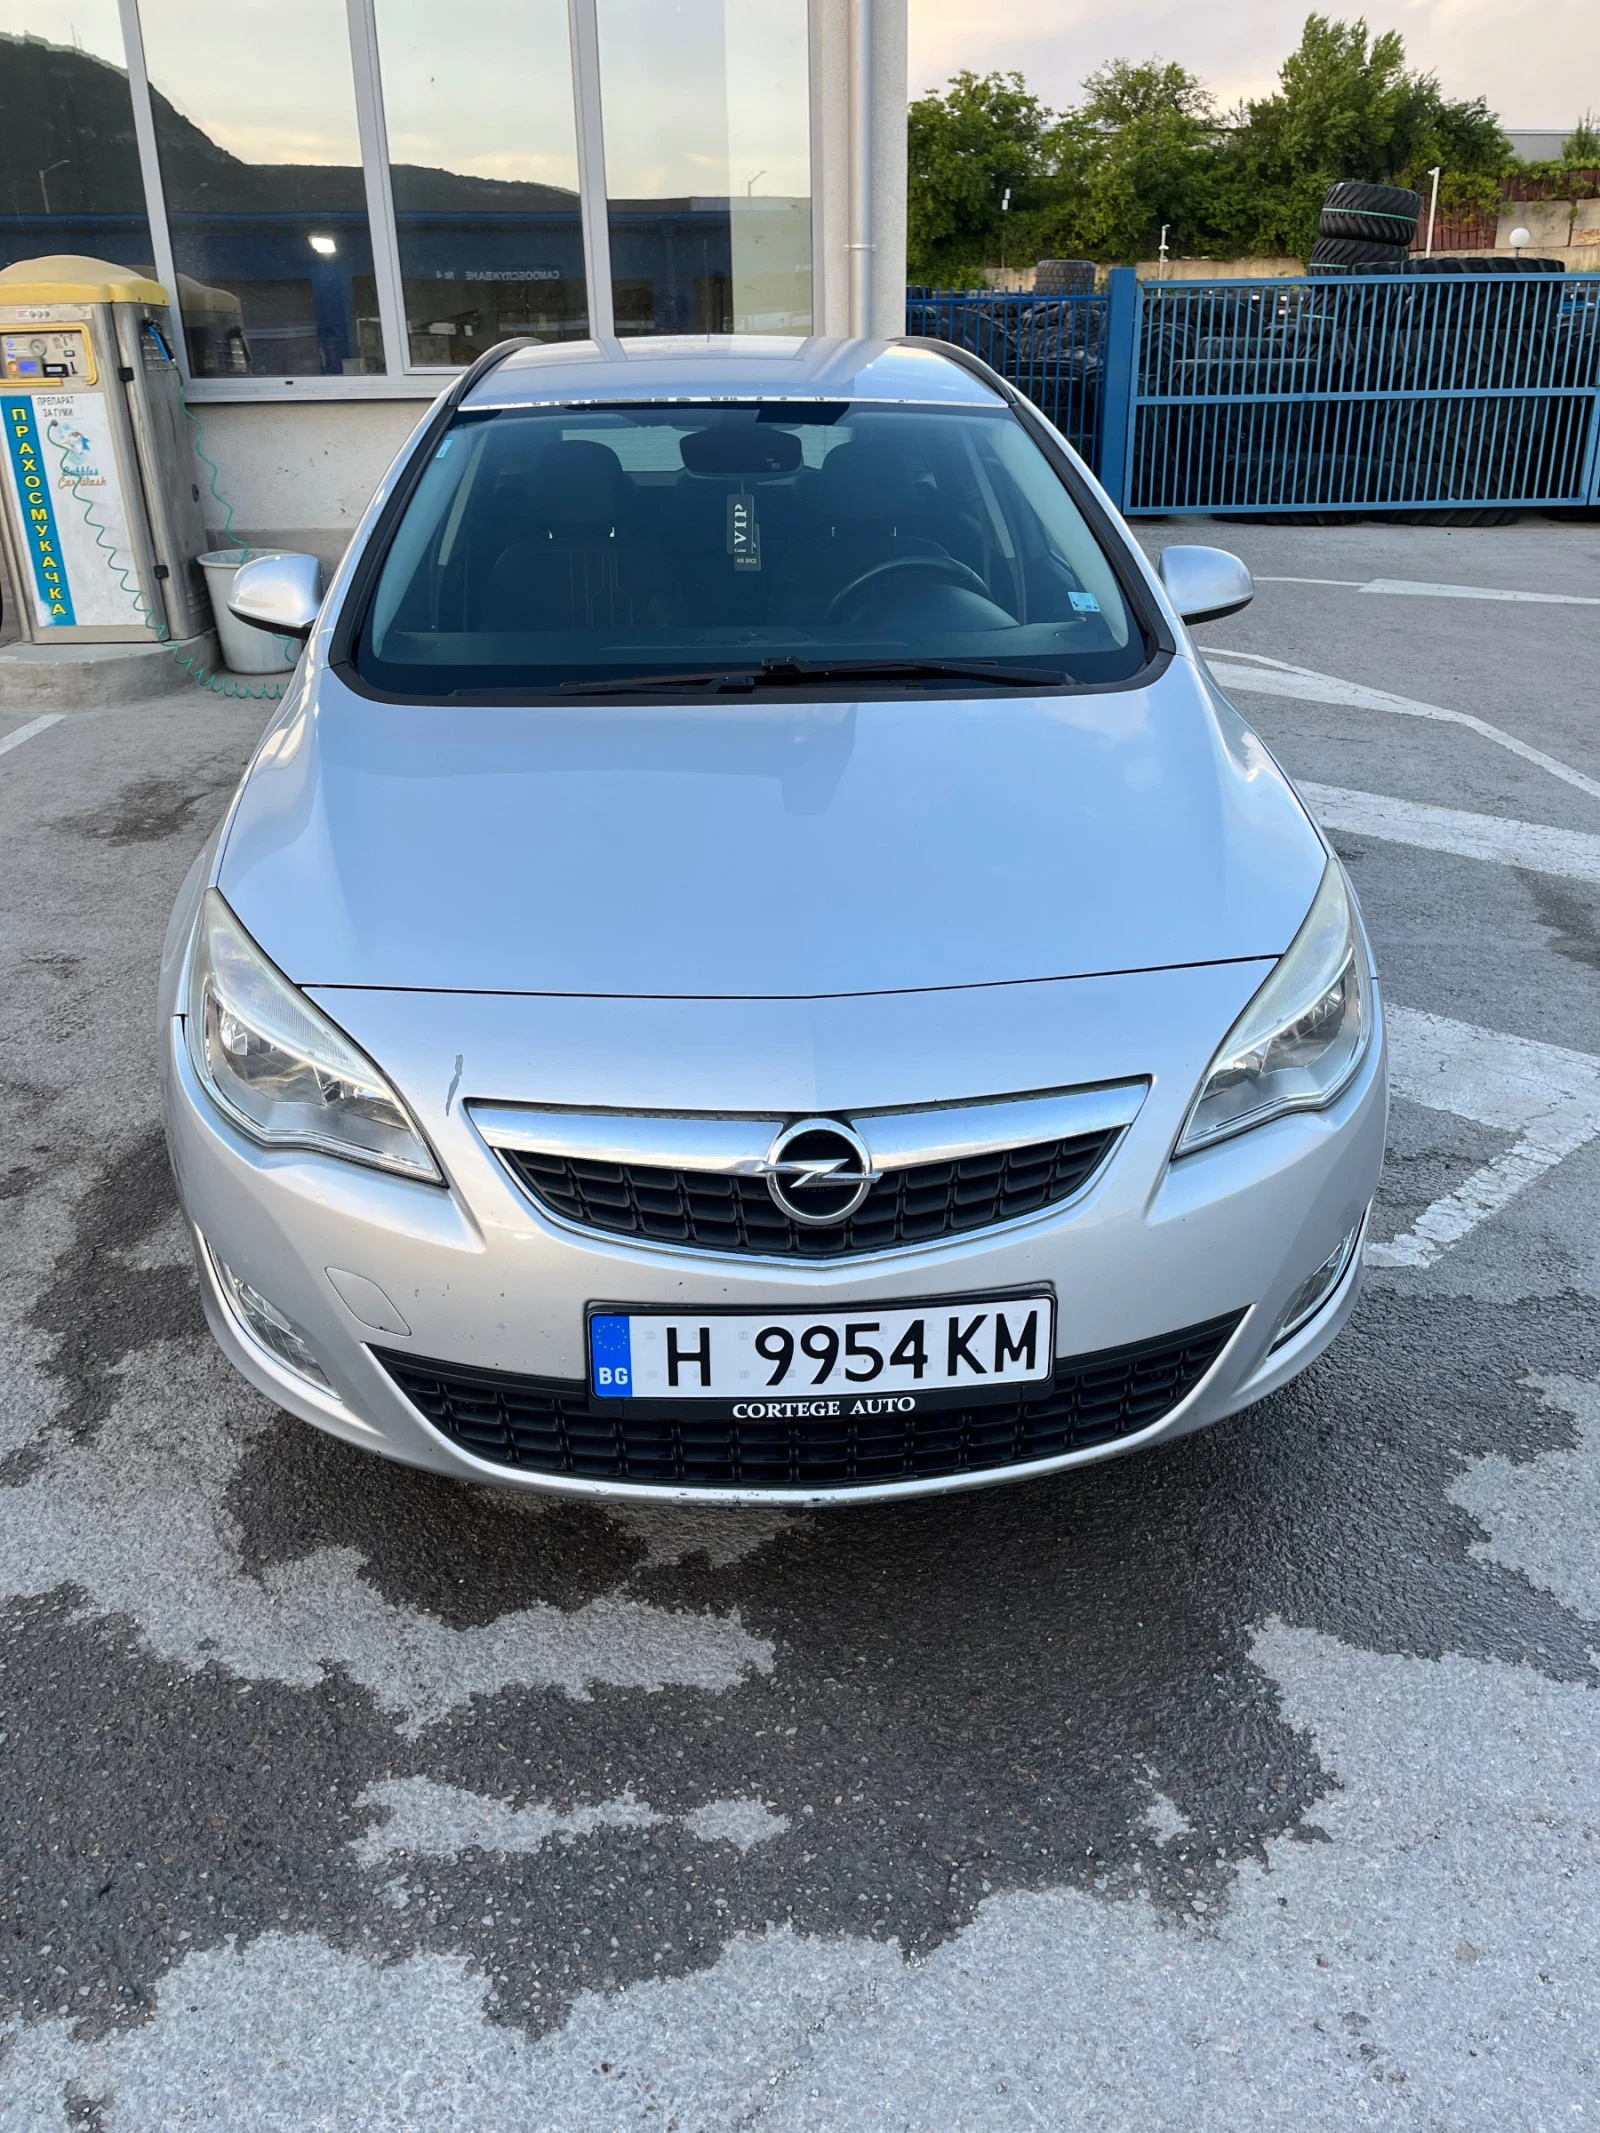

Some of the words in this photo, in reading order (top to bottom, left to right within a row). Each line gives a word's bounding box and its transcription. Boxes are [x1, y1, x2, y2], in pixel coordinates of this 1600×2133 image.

[37, 396, 74, 406] ПРЕПАРАТ
[43, 408, 53, 417] ЗА
[11, 407, 67, 617] ПРАХОСМУКАЧКА
[734, 504, 747, 545] VIP
[786, 1122, 848, 1138] OPEL
[666, 1326, 712, 1387] H
[755, 1318, 929, 1386] 9954
[946, 1310, 1038, 1377] KM
[599, 1366, 629, 1386] BG
[732, 1400, 841, 1420] CORTEGE
[850, 1396, 917, 1415] AUTO
